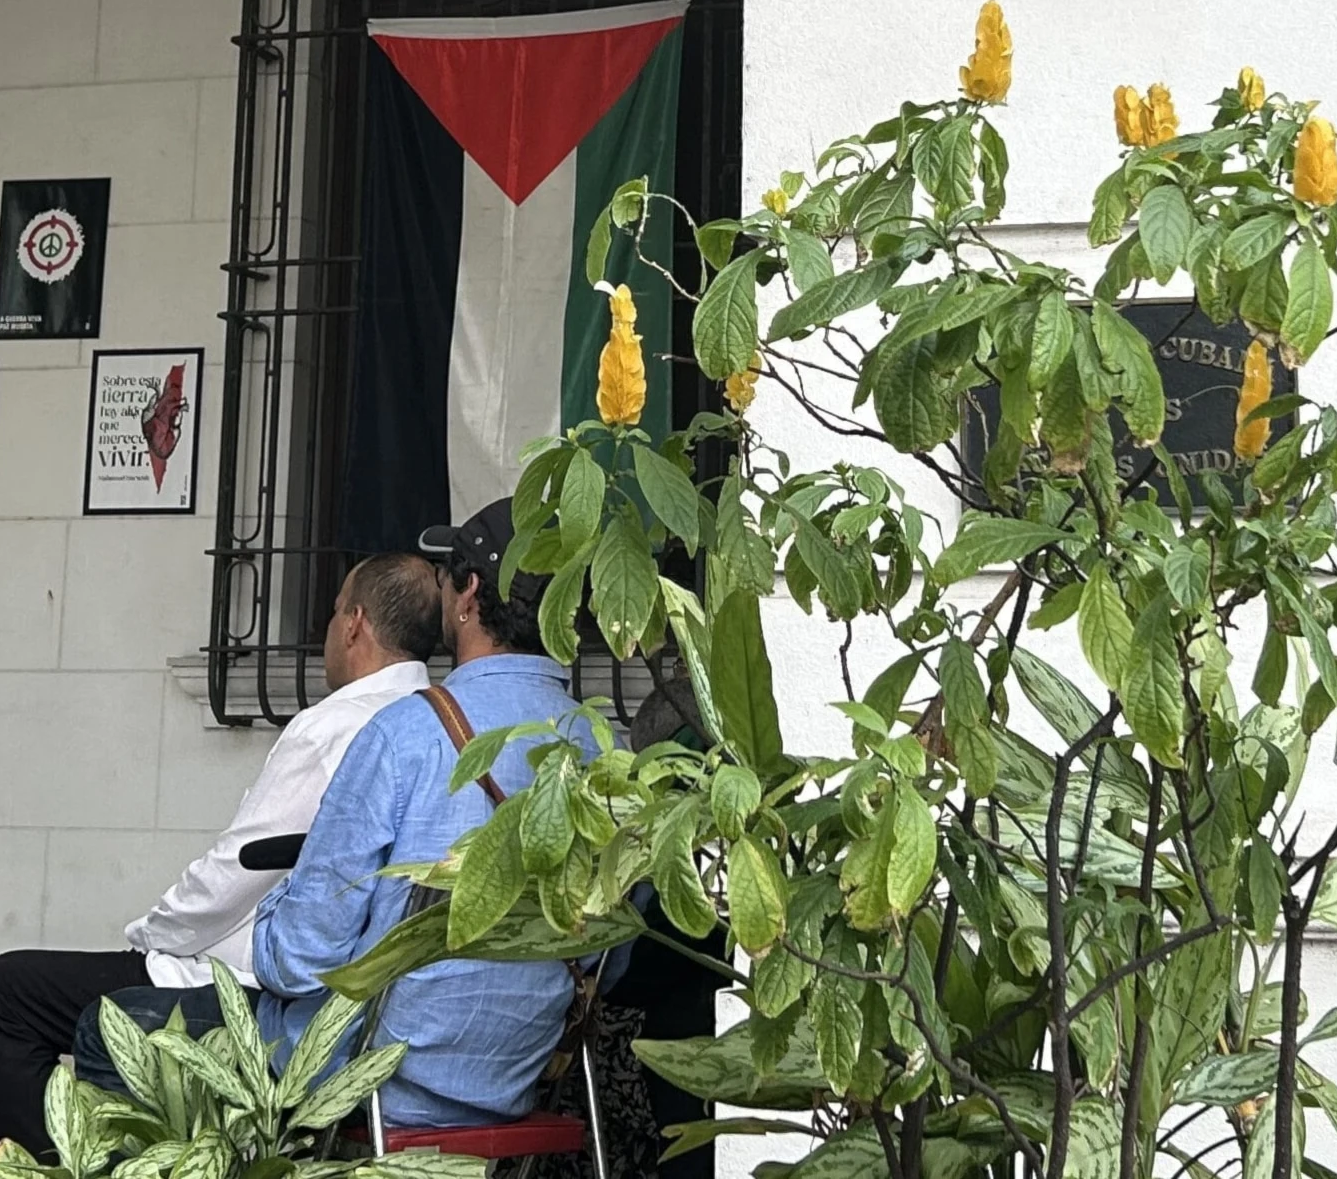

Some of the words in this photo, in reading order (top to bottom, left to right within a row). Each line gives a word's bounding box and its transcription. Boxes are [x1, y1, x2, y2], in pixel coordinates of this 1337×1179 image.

[1159, 336, 1273, 373] CUBA
[102, 375, 137, 387] Sobre
[101, 387, 148, 403] tierra
[100, 405, 117, 419] hay
[99, 421, 120, 433] que
[98, 434, 147, 445] merece
[98, 445, 150, 468] vivir.
